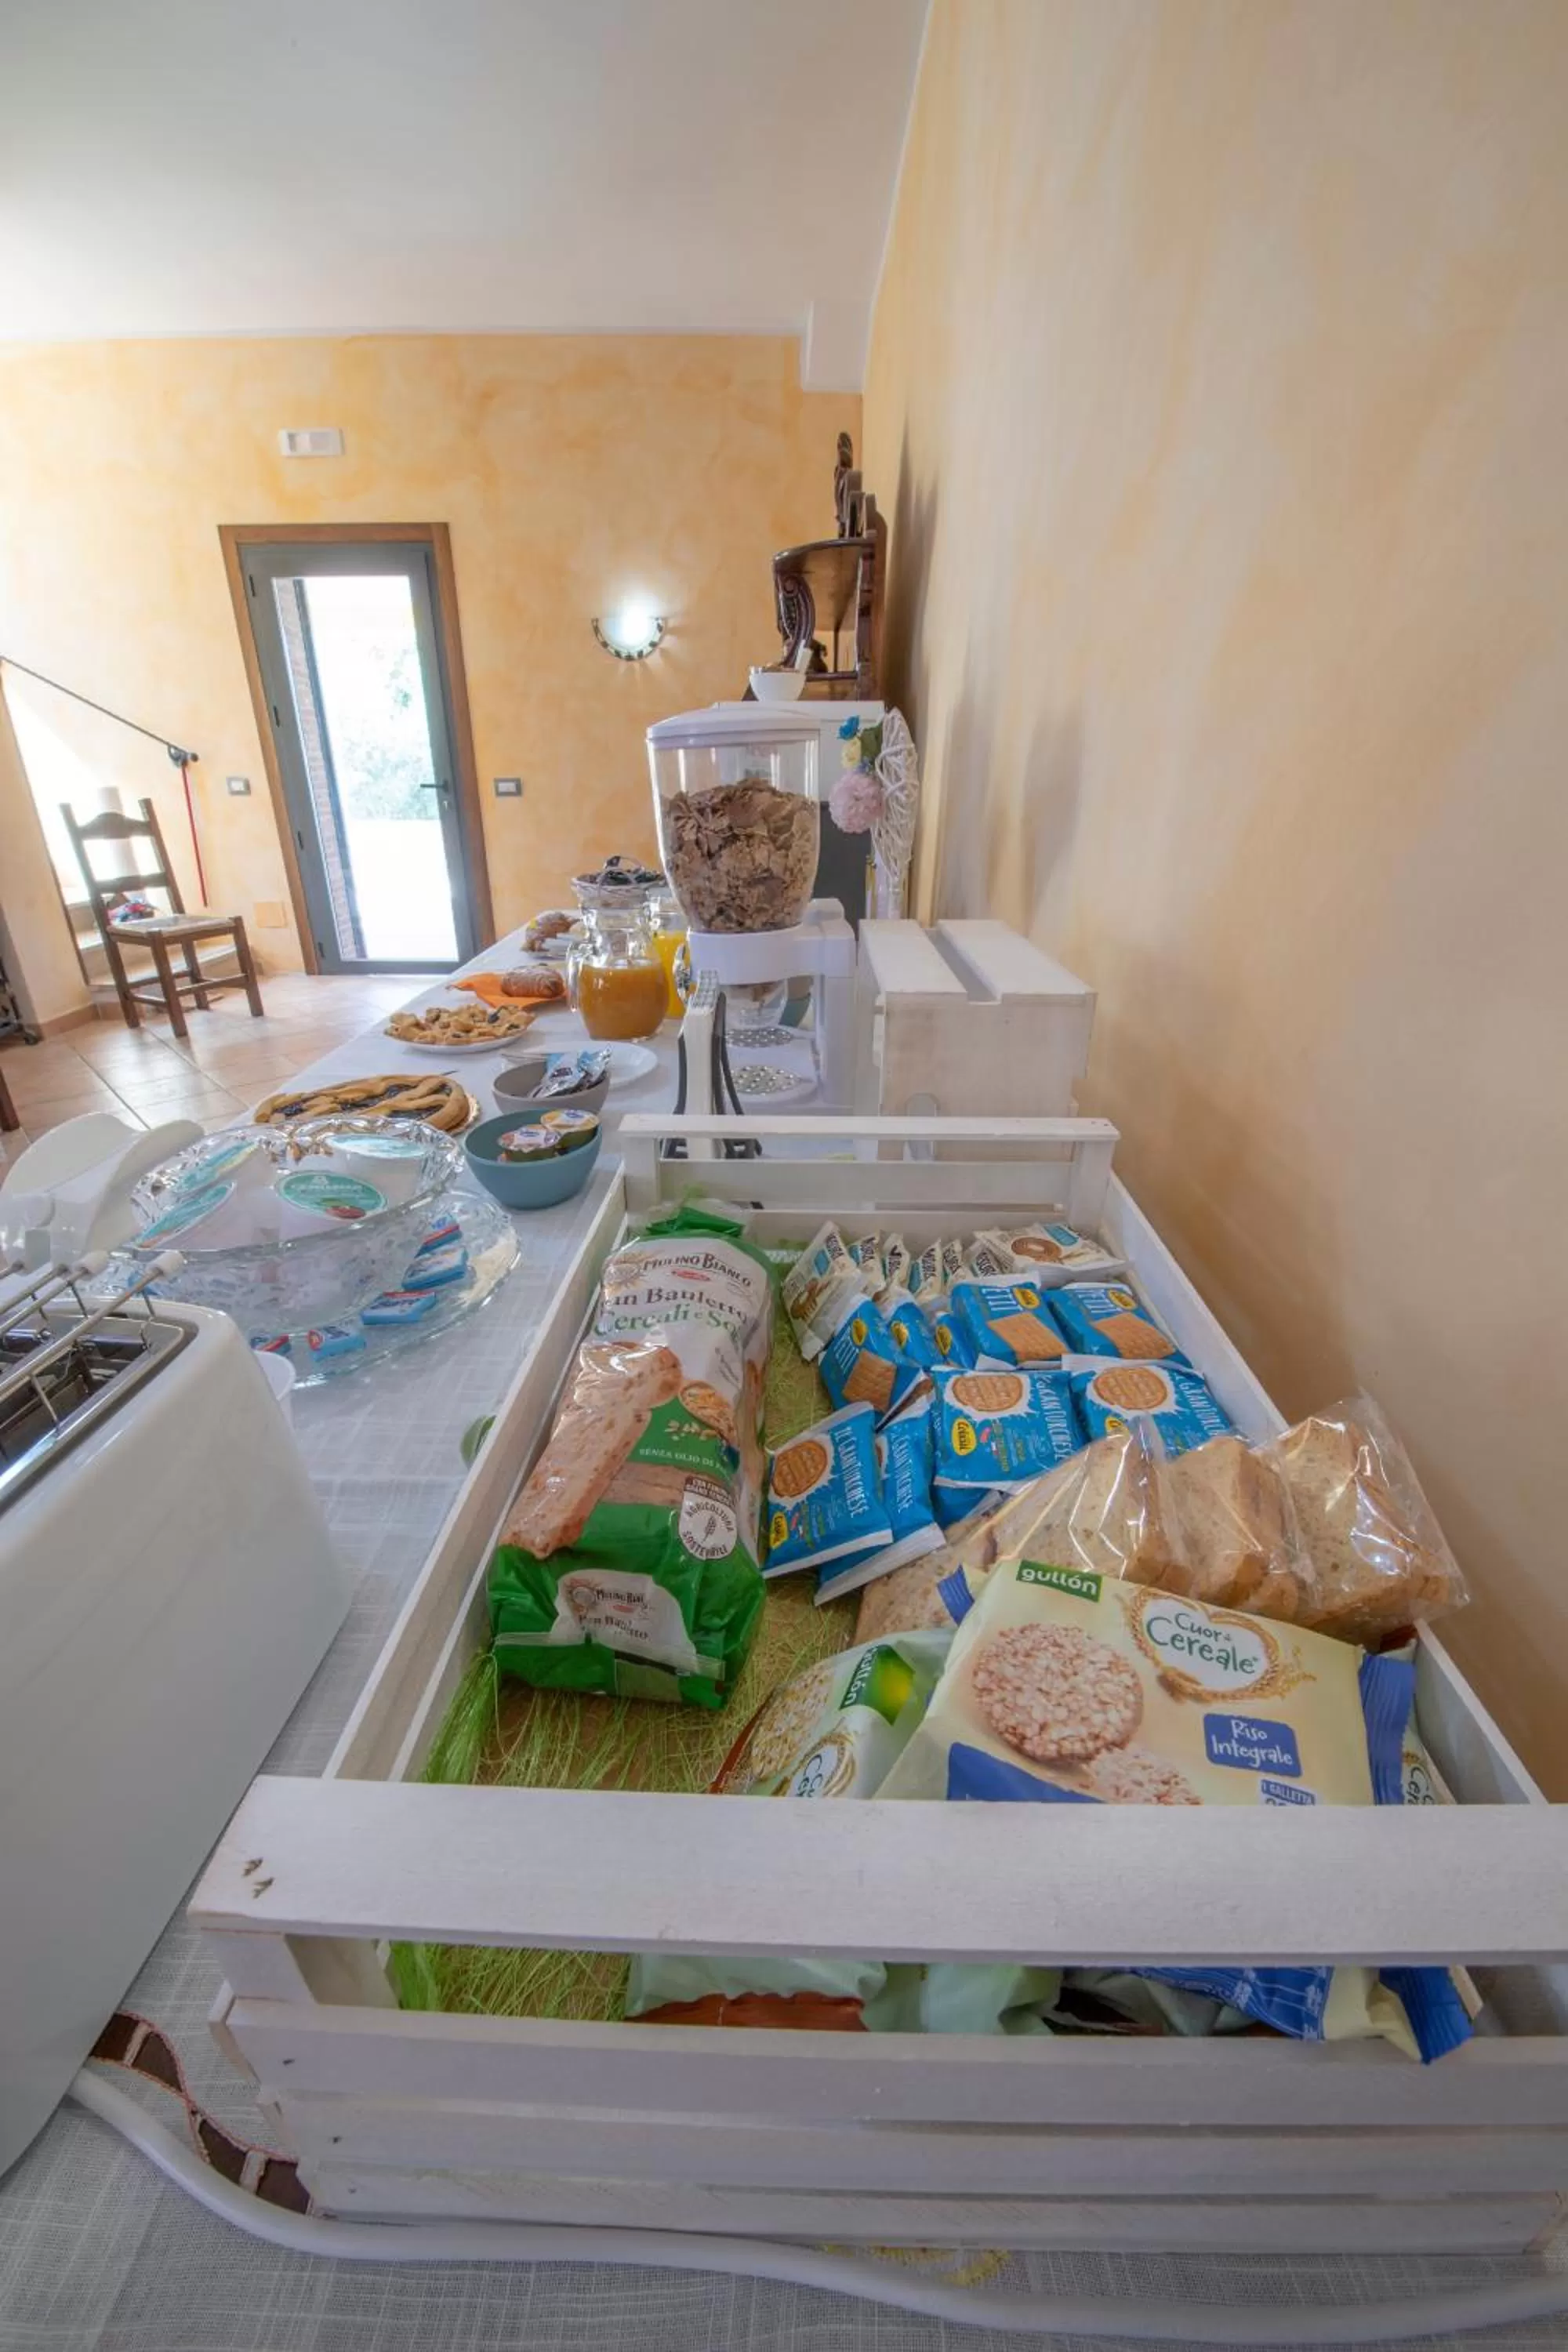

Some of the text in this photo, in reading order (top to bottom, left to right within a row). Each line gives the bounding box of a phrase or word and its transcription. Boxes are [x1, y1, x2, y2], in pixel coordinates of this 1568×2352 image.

[643, 1254, 700, 1272] MULINO
[702, 1252, 752, 1287] BIANCO
[1021, 1568, 1098, 1595] gullón
[1175, 1612, 1221, 1642] Cuor
[1145, 1616, 1256, 1675] Cereale
[1231, 1719, 1268, 1740] Riso
[1211, 1735, 1293, 1769] Integrale
